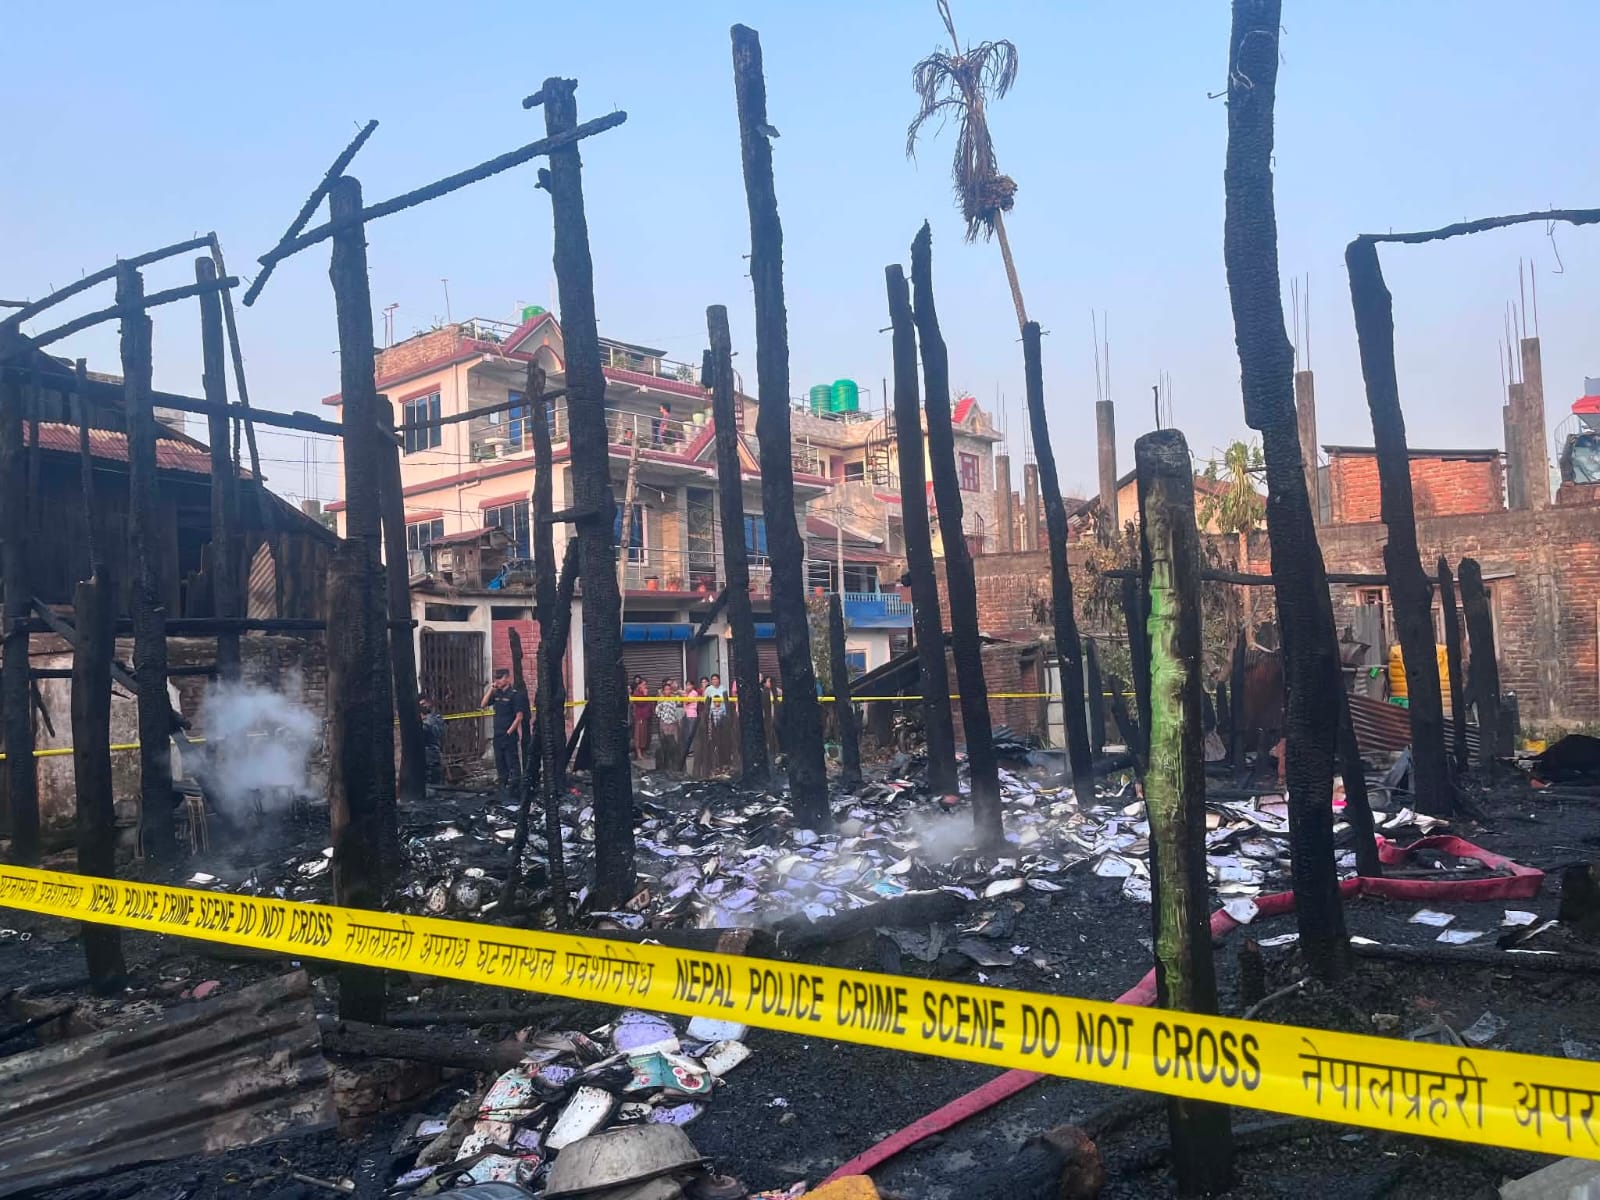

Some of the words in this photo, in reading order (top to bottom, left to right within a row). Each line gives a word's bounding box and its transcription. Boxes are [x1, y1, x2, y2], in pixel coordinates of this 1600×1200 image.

[89, 884, 119, 914] NEPAL
[121, 887, 159, 921] POLICE
[158, 891, 195, 926] CRIME
[195, 895, 236, 932] SCENE
[236, 902, 258, 935] DO
[257, 905, 287, 940] NOT
[288, 908, 334, 947] CROSS
[672, 957, 735, 1009] NEPAL
[745, 967, 825, 1022] POLICE
[837, 978, 909, 1035] CRIME
[921, 990, 1006, 1051] SCENE
[1020, 1003, 1061, 1059] DO
[1075, 1010, 1135, 1070] NOT
[1152, 1021, 1261, 1091] CROSS
[1297, 1036, 1489, 1129] नेपालप्रहरी
